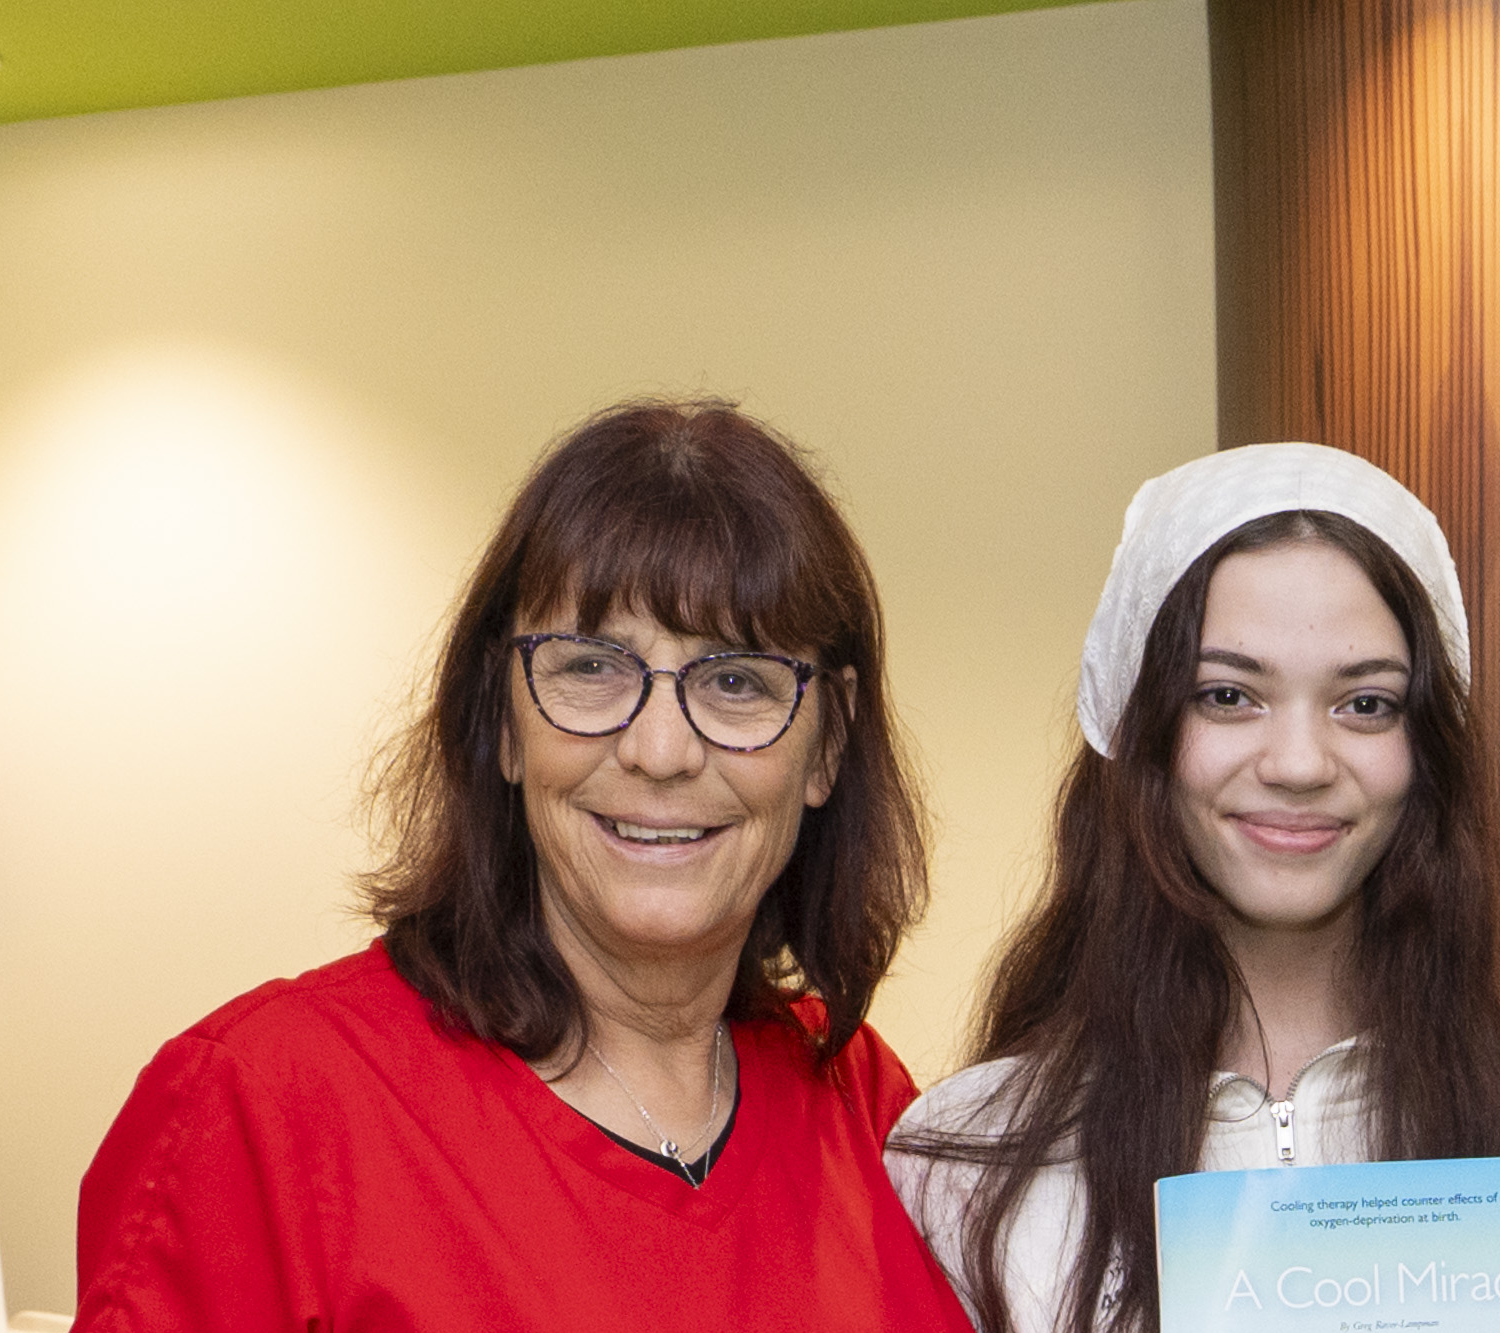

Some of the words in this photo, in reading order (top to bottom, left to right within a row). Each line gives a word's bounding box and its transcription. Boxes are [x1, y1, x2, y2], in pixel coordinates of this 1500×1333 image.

[1271, 1200, 1315, 1213] Cooling
[1317, 1198, 1358, 1212] therapy
[1361, 1196, 1398, 1210] helped
[1401, 1196, 1445, 1207] counter
[1448, 1193, 1483, 1205] effects
[1486, 1192, 1499, 1203] of
[1310, 1213, 1415, 1229] oxygen-deprivation
[1418, 1213, 1429, 1223] at
[1432, 1211, 1461, 1223] birth.
[1225, 1269, 1263, 1312] A
[1276, 1263, 1381, 1310] Cool
